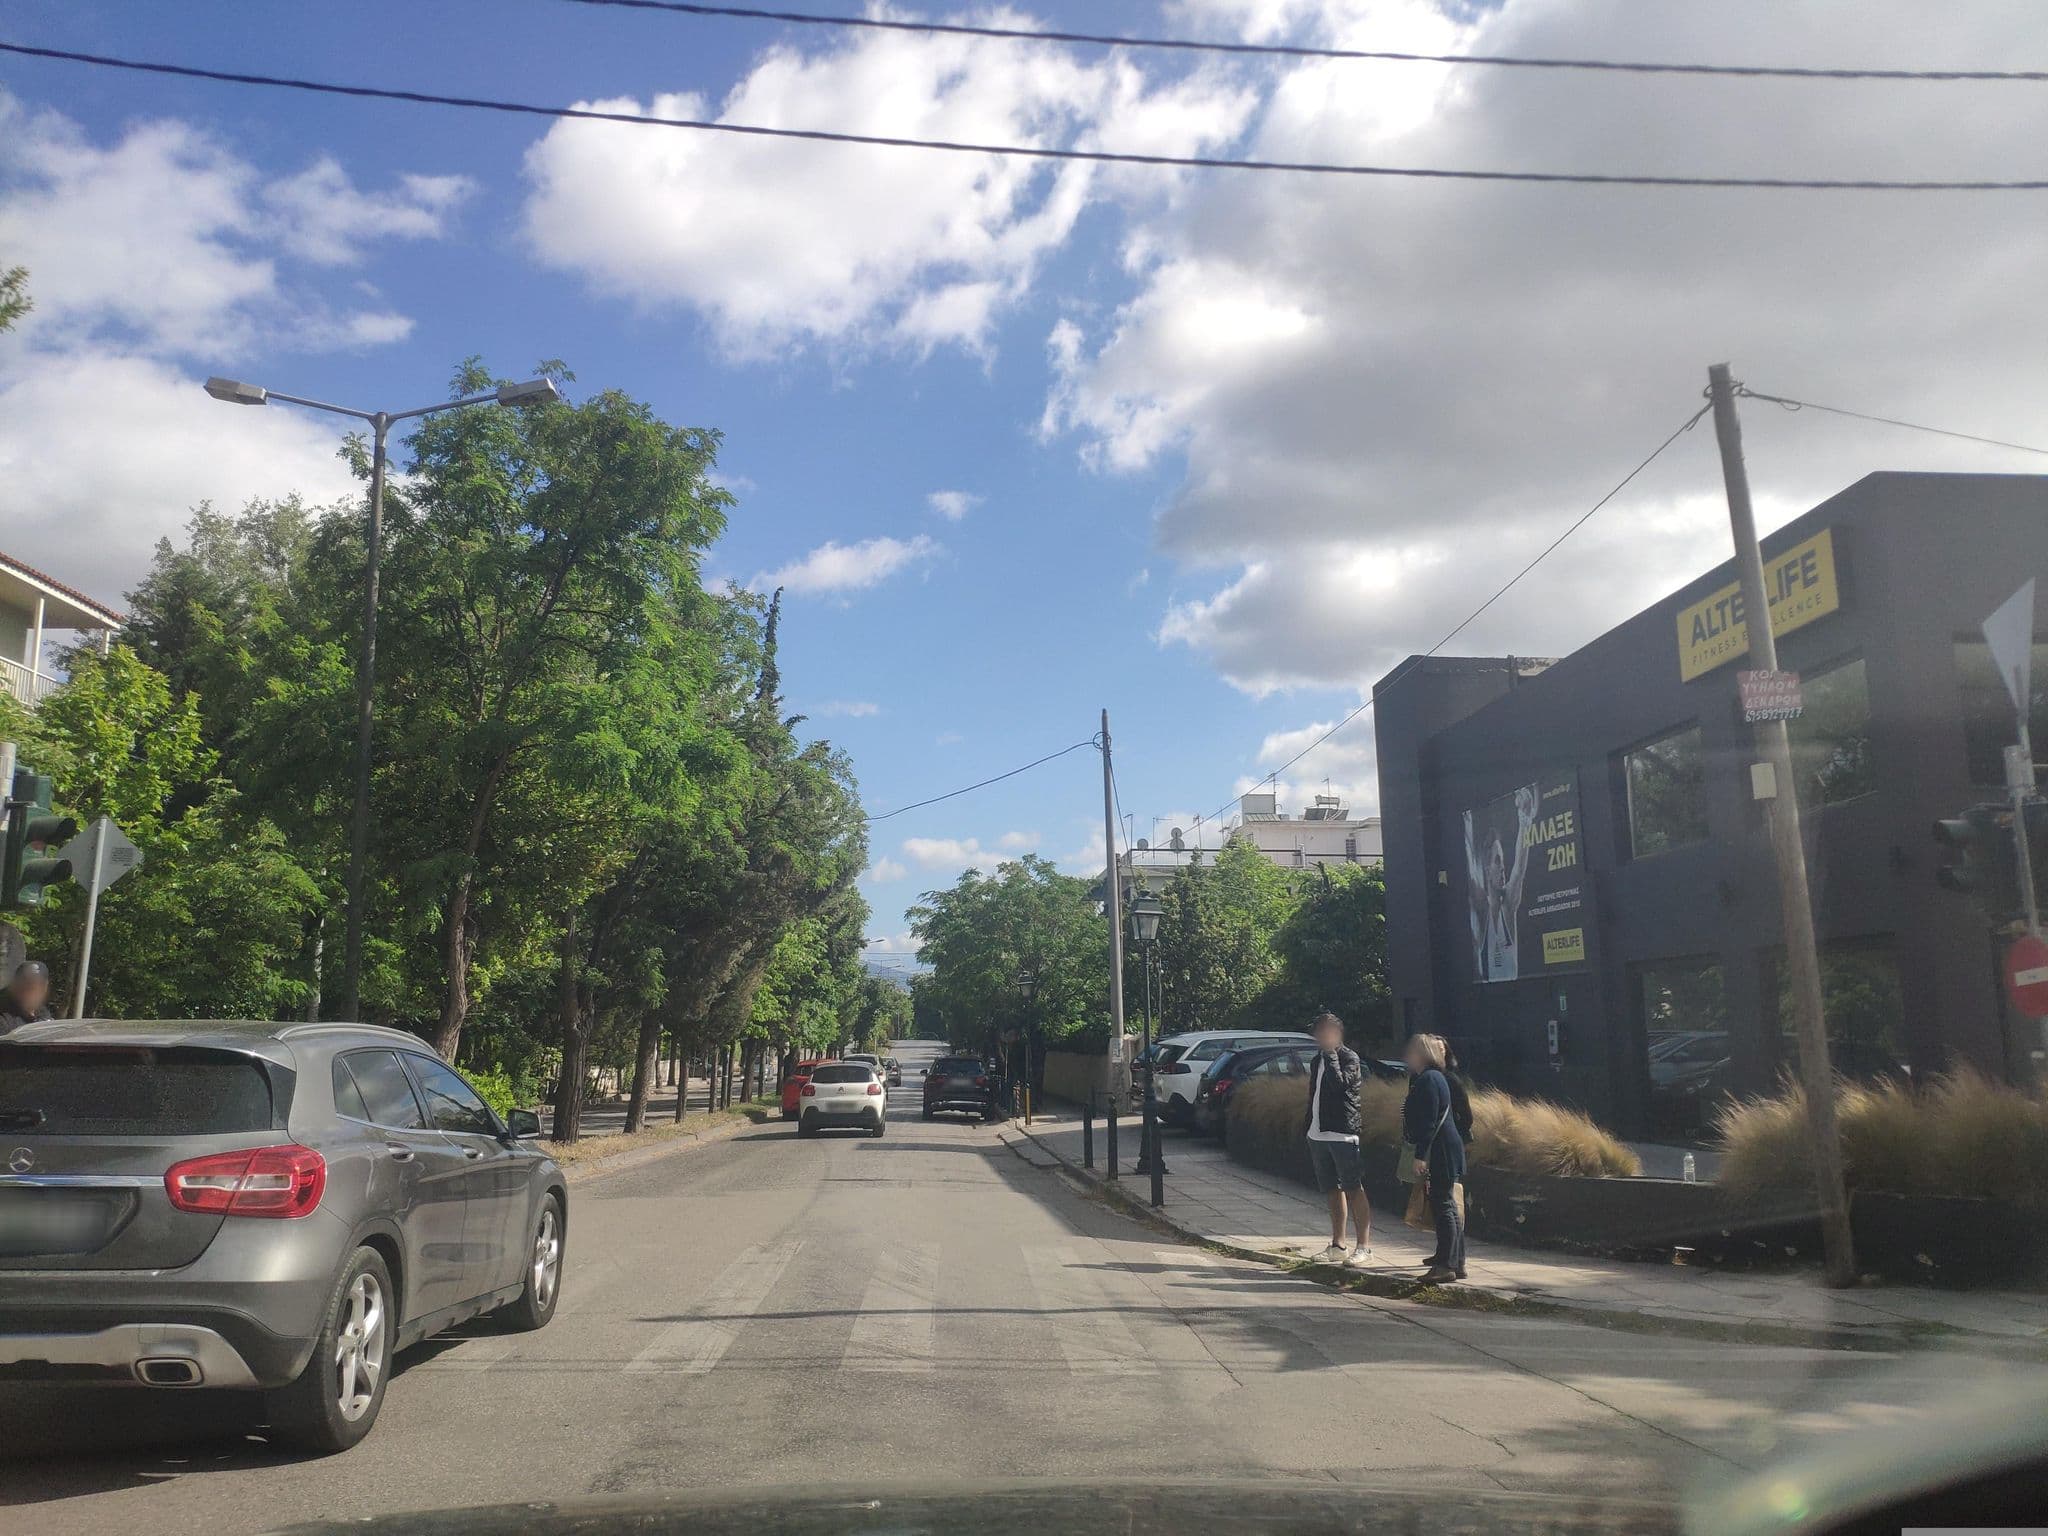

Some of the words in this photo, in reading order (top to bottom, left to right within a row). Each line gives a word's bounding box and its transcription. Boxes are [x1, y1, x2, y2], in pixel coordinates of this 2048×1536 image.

[1690, 547, 1819, 649] ALTELIFE
[1522, 810, 1574, 849] ΑΛΛΑΞΕ
[1547, 841, 1576, 872] ΖΩΗ
[1546, 934, 1581, 951] ALTERLIFE
